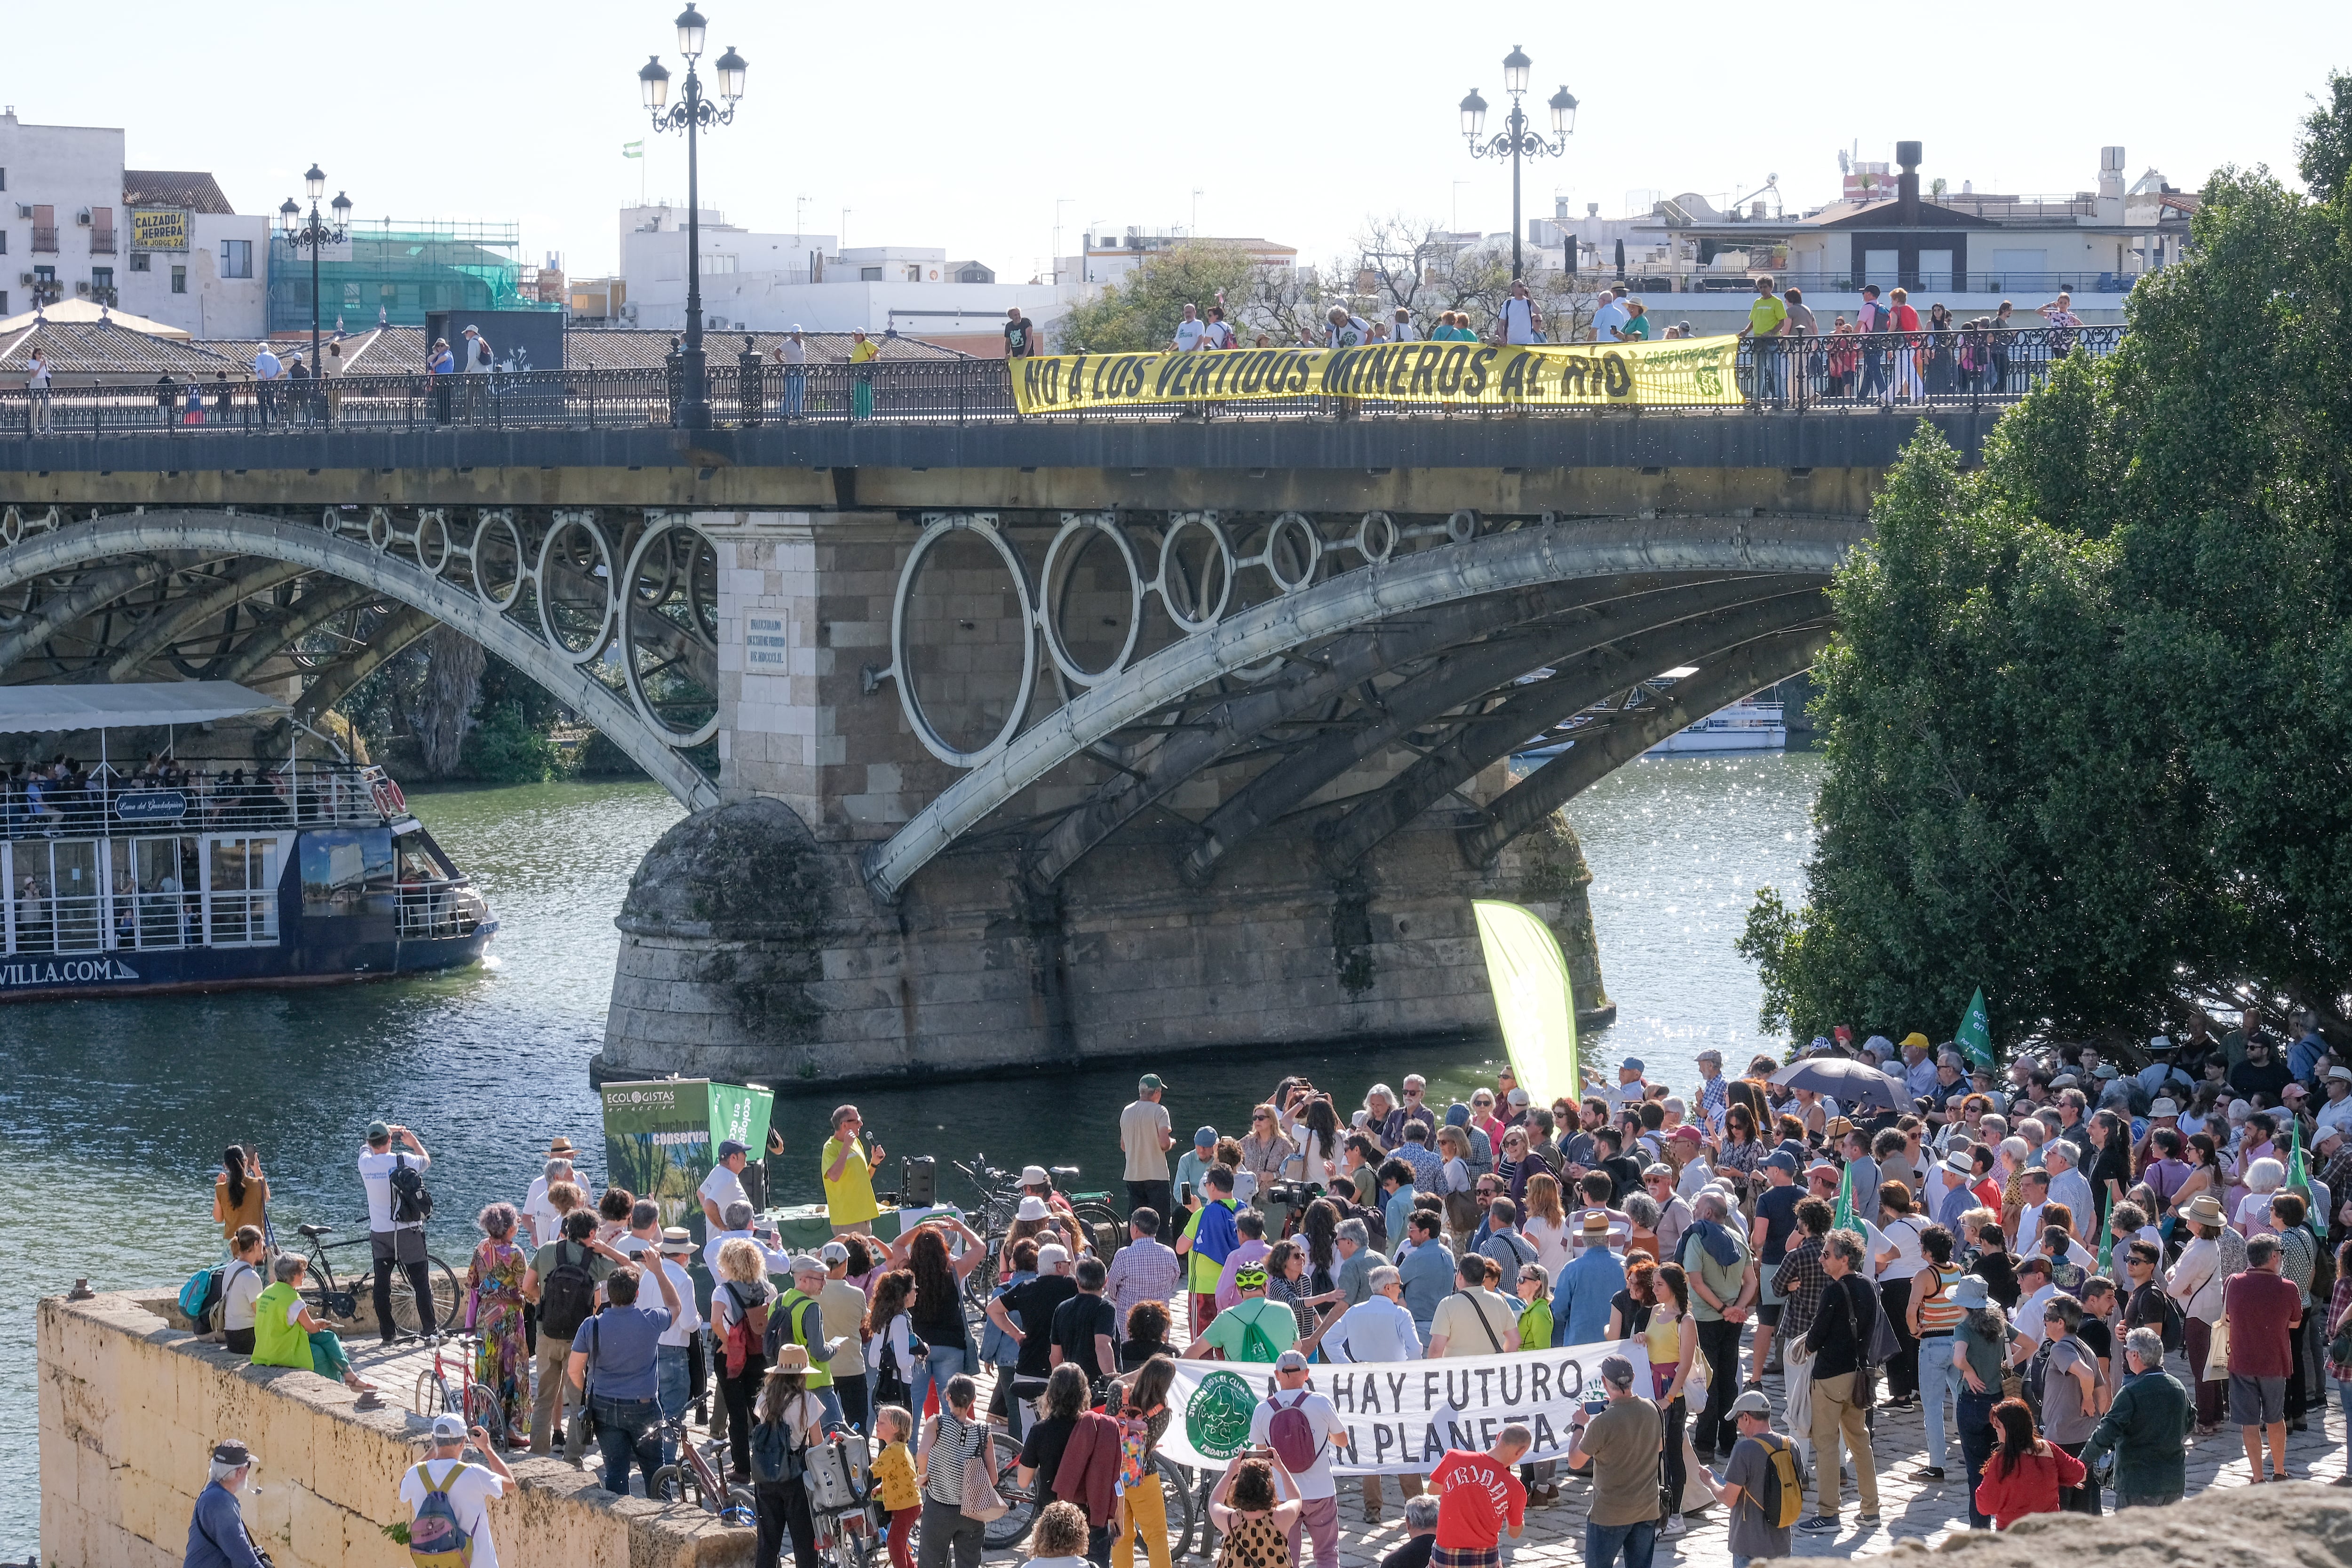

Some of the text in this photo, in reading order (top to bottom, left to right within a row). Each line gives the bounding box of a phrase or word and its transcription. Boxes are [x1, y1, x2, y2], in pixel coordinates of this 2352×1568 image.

[136, 213, 182, 228] CALZADOS
[143, 226, 183, 239] HERRERA
[1645, 346, 1724, 365] GREENPEACE
[1025, 358, 1061, 408] NO
[1068, 357, 1087, 402] A
[1092, 356, 1158, 400] LOS
[1155, 350, 1322, 396] VERTIDOS
[1321, 345, 1498, 396] MINEROS
[1499, 352, 1547, 396] AL
[751, 651, 757, 662] DE
[119, 798, 184, 812] Luna del Guadalquivir
[0, 960, 112, 985] VILLA.COM
[1973, 1022, 1984, 1032] en
[1960, 1037, 1970, 1046] Por
[1974, 1048, 1990, 1060] mundo
[607, 1090, 675, 1104] ECOLOGISTAS
[733, 1103, 740, 1118] en
[652, 1119, 689, 1132] mucho
[652, 1131, 709, 1146] conservar
[1333, 1373, 1406, 1414] HAY
[1424, 1360, 1582, 1411] FUTURO
[1188, 1379, 1214, 1417] JUVENTUD
[1219, 1375, 1227, 1384] EL
[1229, 1377, 1250, 1399] CLIMA
[1200, 1443, 1245, 1457] FRIDAYS FOR
